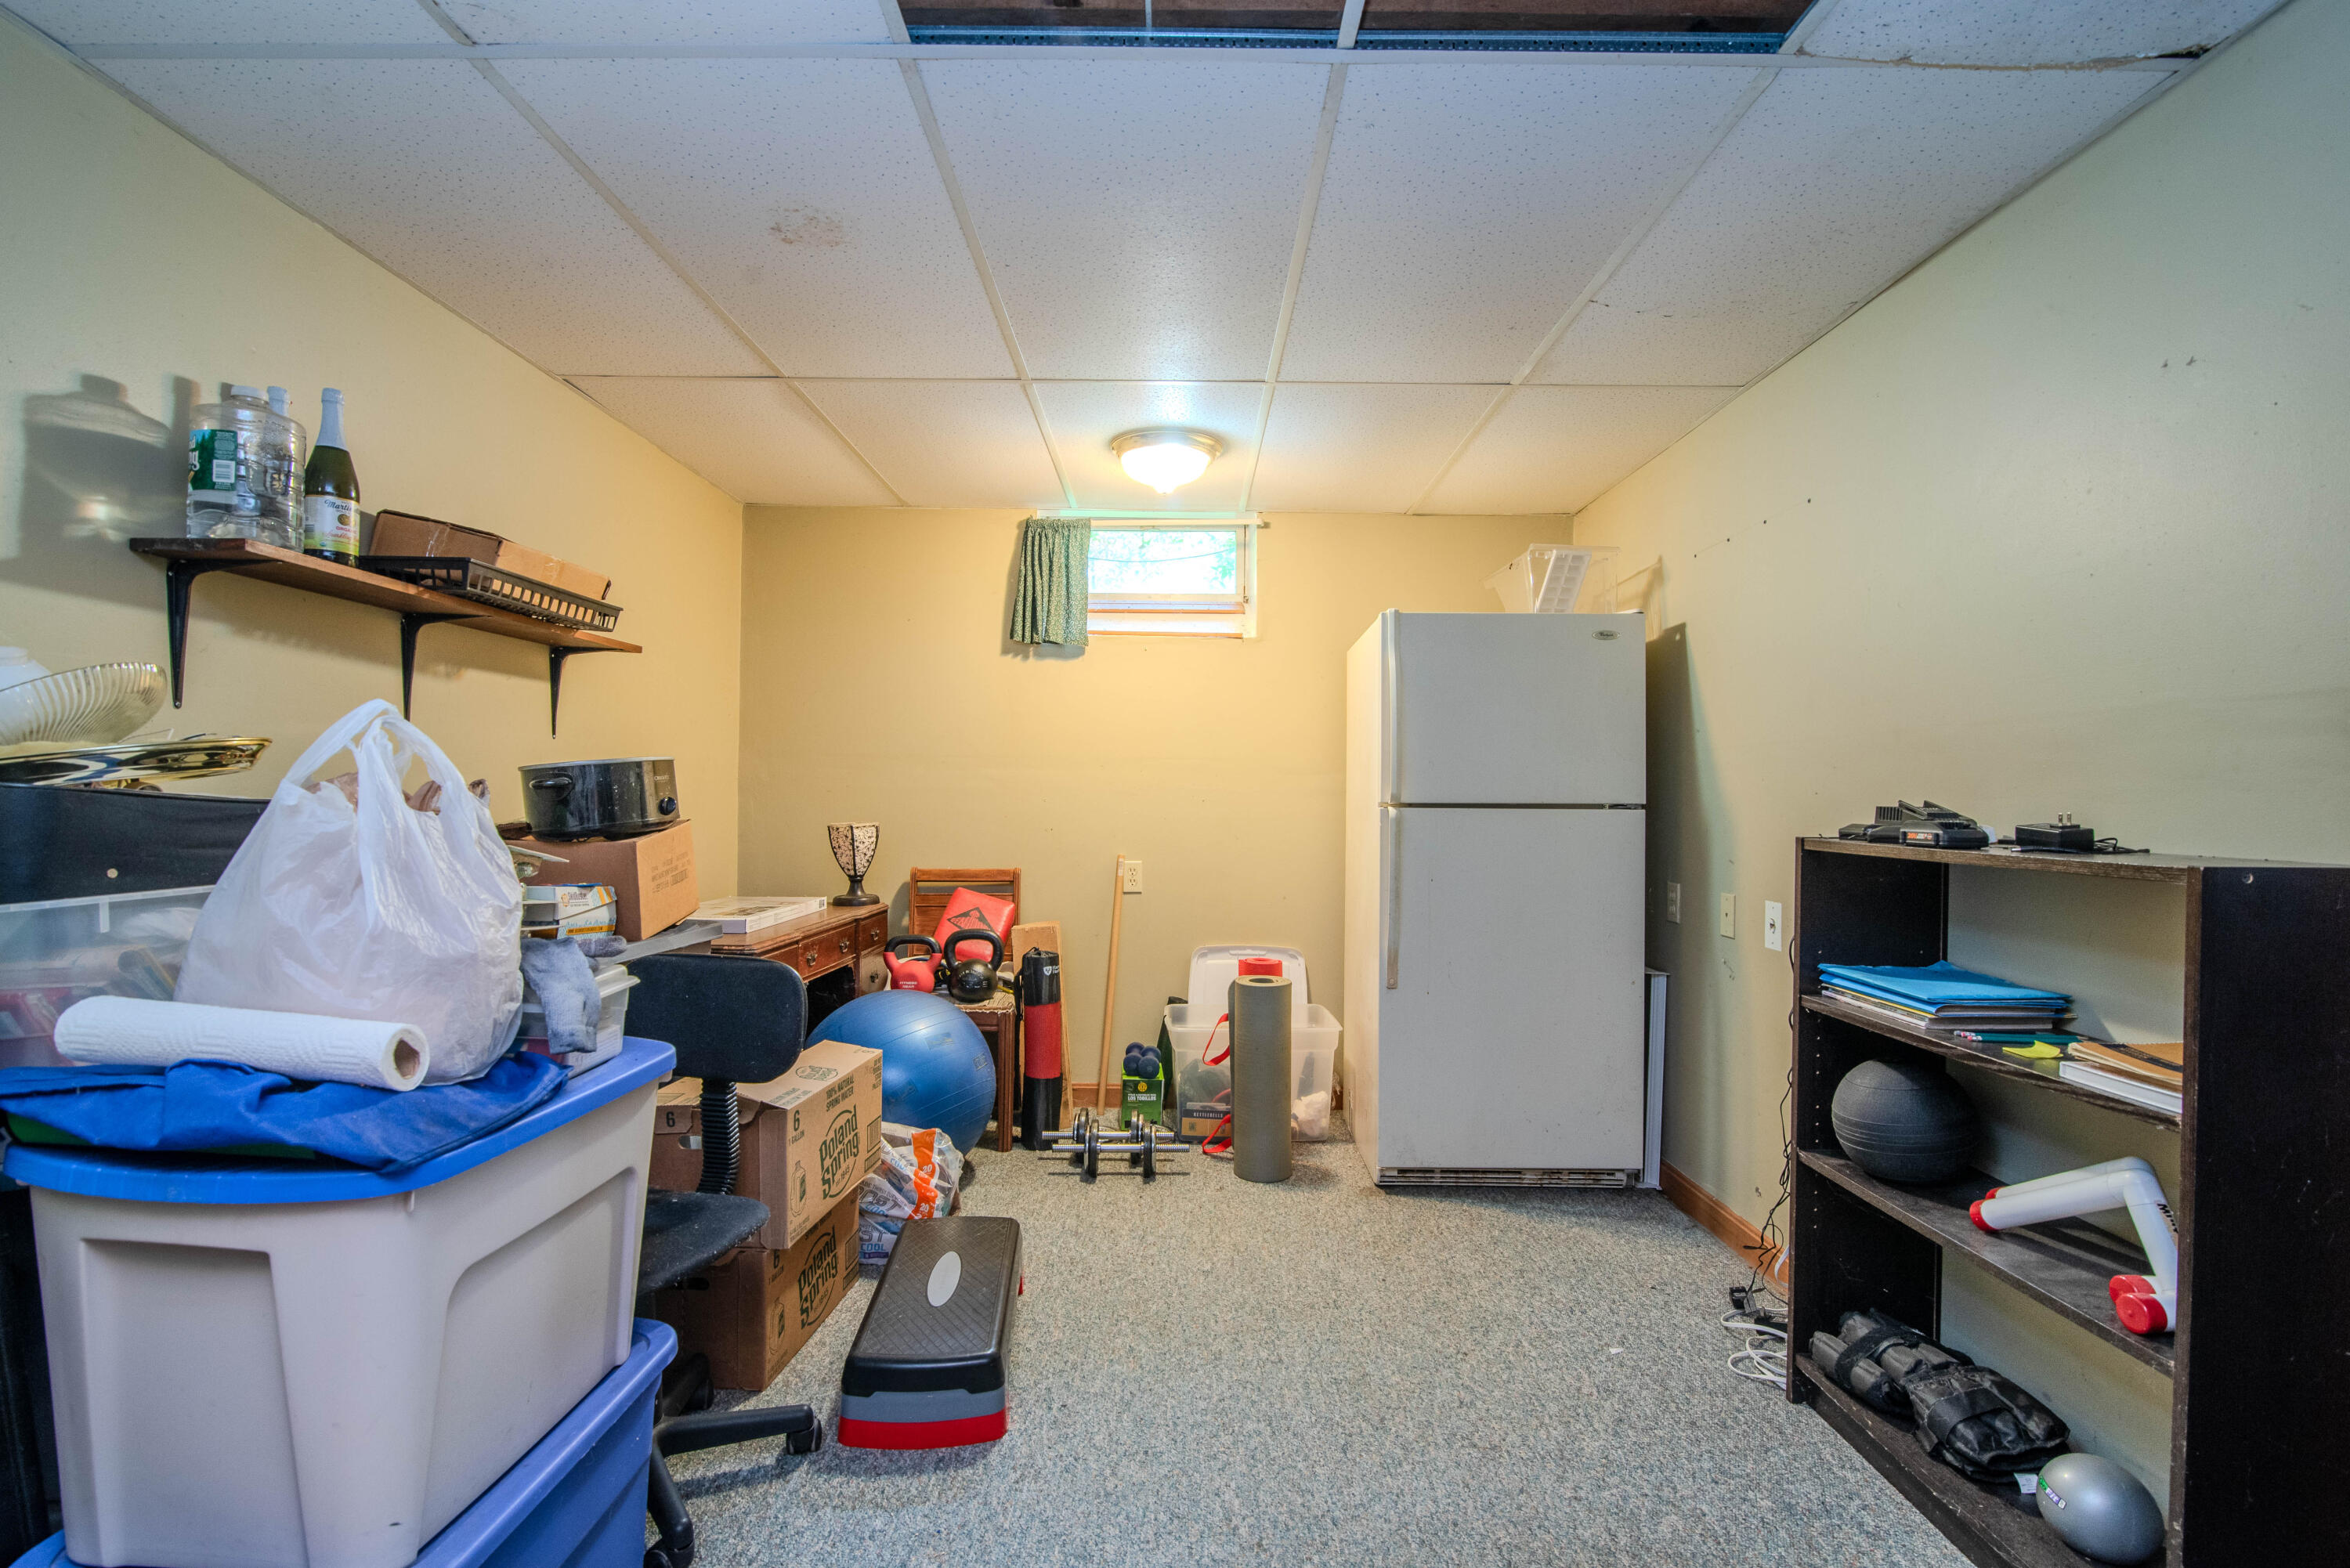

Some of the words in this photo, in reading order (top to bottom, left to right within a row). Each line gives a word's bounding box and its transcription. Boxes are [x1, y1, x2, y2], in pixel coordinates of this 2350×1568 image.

[837, 1074, 855, 1093] NATURAL
[826, 1097, 841, 1112] SPRING
[841, 1086, 854, 1102] WATER
[666, 1111, 675, 1128] 6
[794, 1109, 801, 1132] 6
[791, 1129, 804, 1145] GALLON
[819, 1104, 858, 1176] Poland
[822, 1132, 859, 1201] Spring
[860, 1242, 886, 1252] COOL
[797, 1224, 837, 1304] Poland
[800, 1252, 838, 1330] Spring
